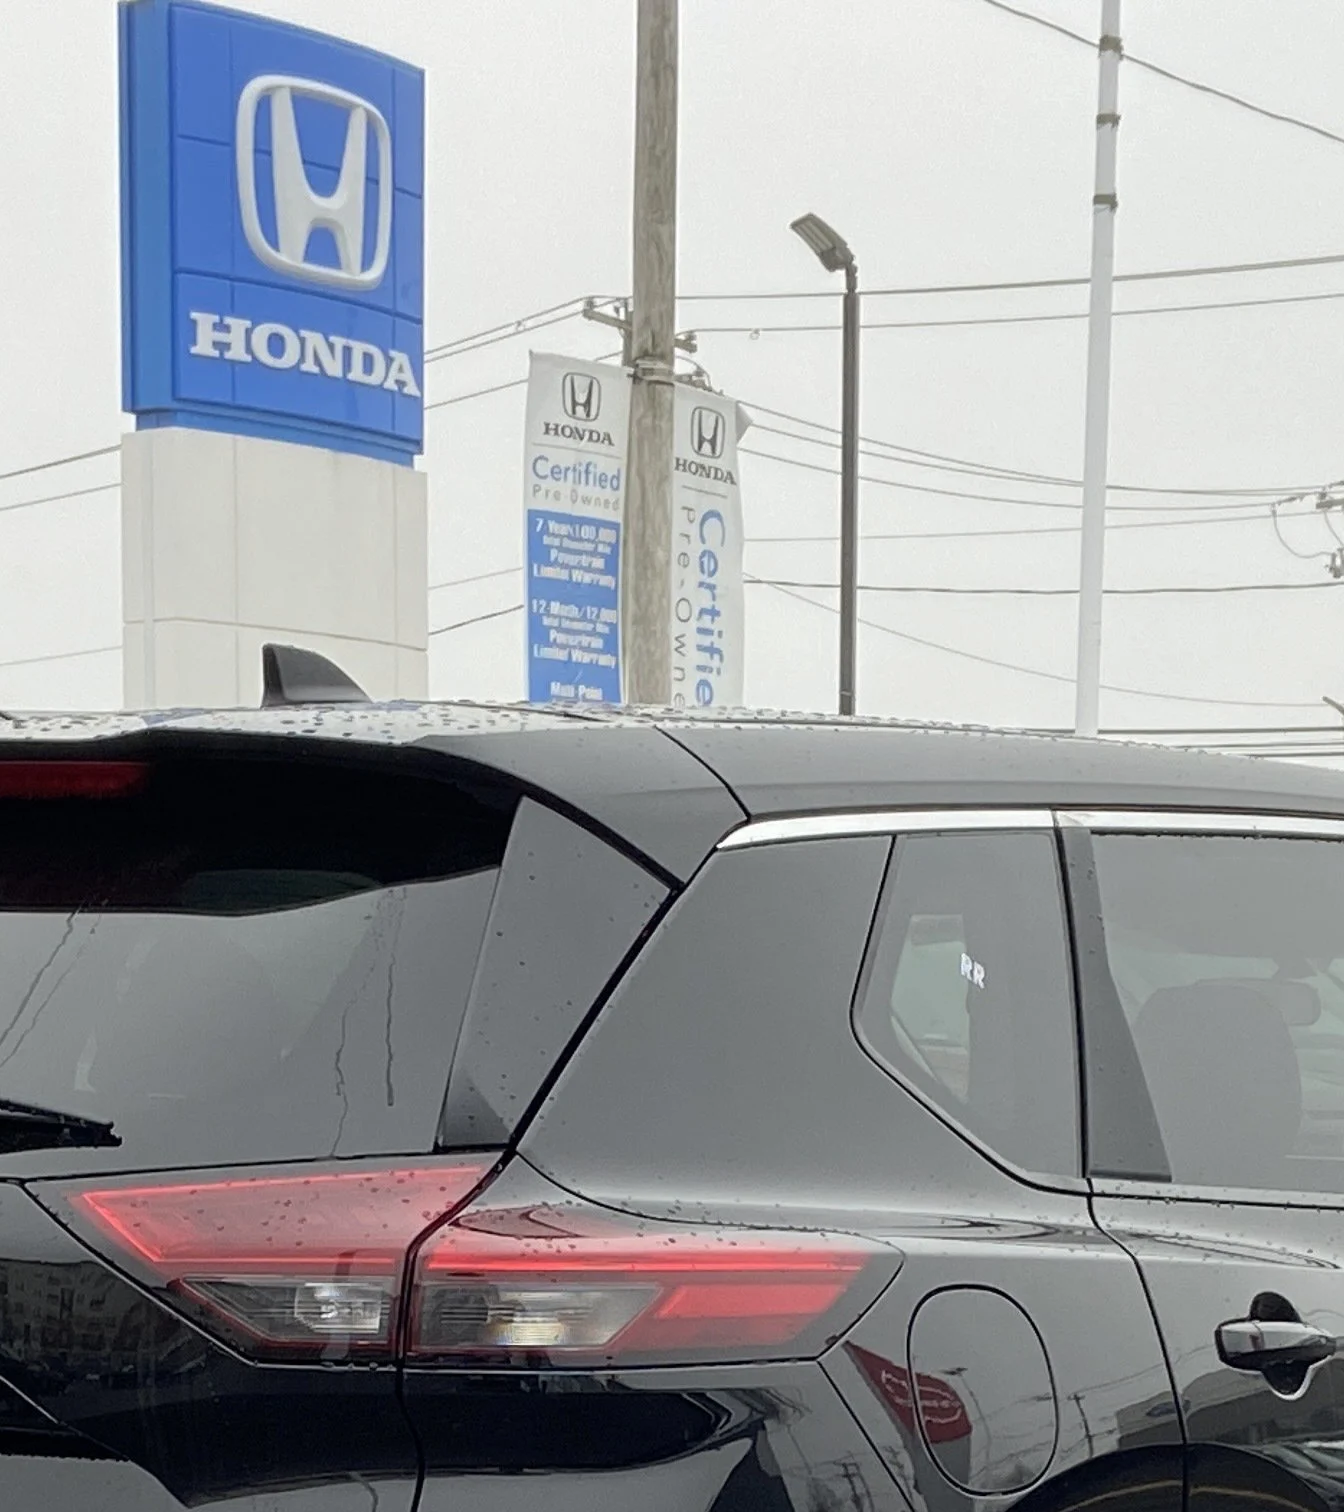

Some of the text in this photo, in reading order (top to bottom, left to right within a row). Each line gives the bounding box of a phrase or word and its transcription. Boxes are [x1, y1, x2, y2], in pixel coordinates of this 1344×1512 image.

[189, 310, 422, 397] HONDA
[543, 421, 615, 447] HONDA
[532, 454, 621, 492] Certified
[673, 457, 737, 486] HONDA
[673, 505, 696, 708] Pre-Owne
[695, 509, 726, 707] Certifie
